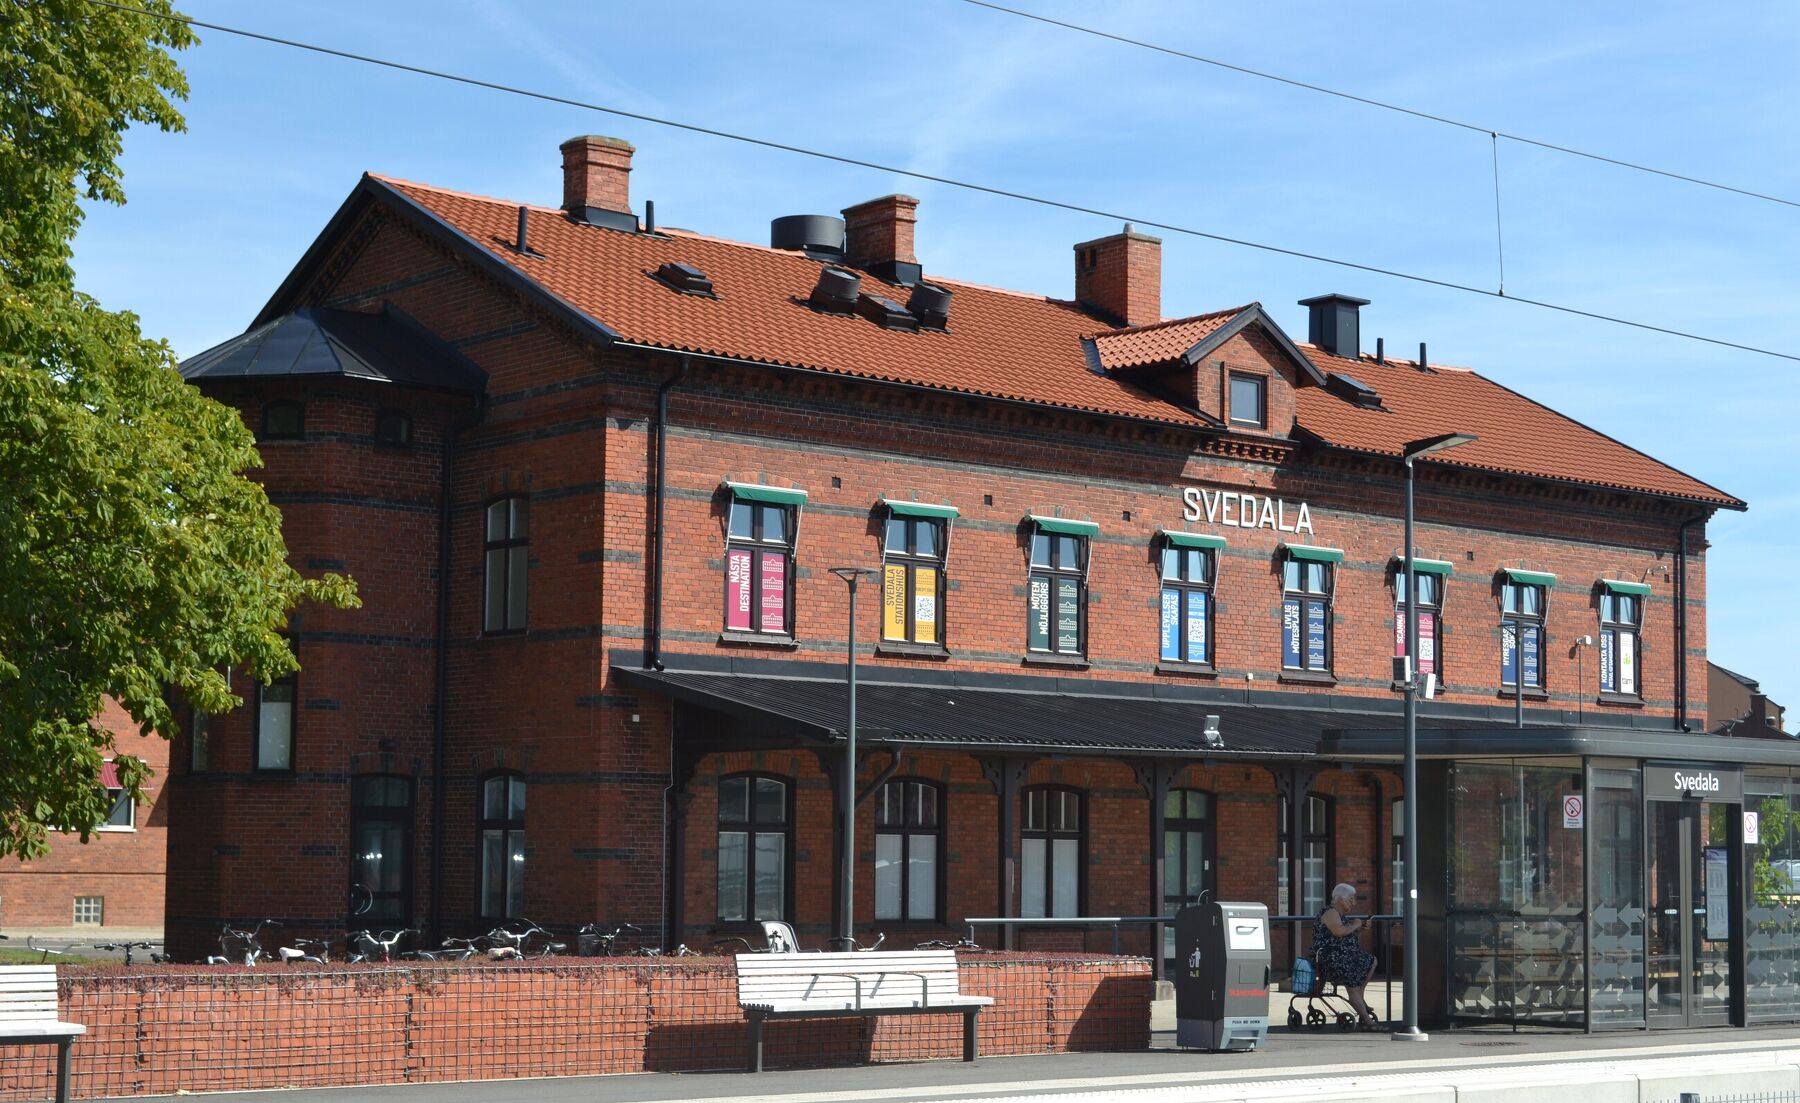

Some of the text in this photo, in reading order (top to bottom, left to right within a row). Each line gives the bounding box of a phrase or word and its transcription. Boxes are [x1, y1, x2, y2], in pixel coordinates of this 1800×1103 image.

[1183, 487, 1314, 535] SVEDALA
[729, 555, 740, 583] NÄSTA
[740, 555, 750, 612] DESTINATION
[886, 568, 895, 606] SVEDALA
[895, 569, 904, 625] STATIONSHUS
[1031, 581, 1040, 610] MÖTEN
[1039, 582, 1048, 635] MÖJLIGGÖRS
[1284, 604, 1292, 629] LIVLIG
[1163, 593, 1171, 648] UPPLEVELSER
[1291, 605, 1299, 654] MÖTESPLATS
[1396, 614, 1404, 644] SCANNA
[1674, 772, 1719, 791] Svedala
